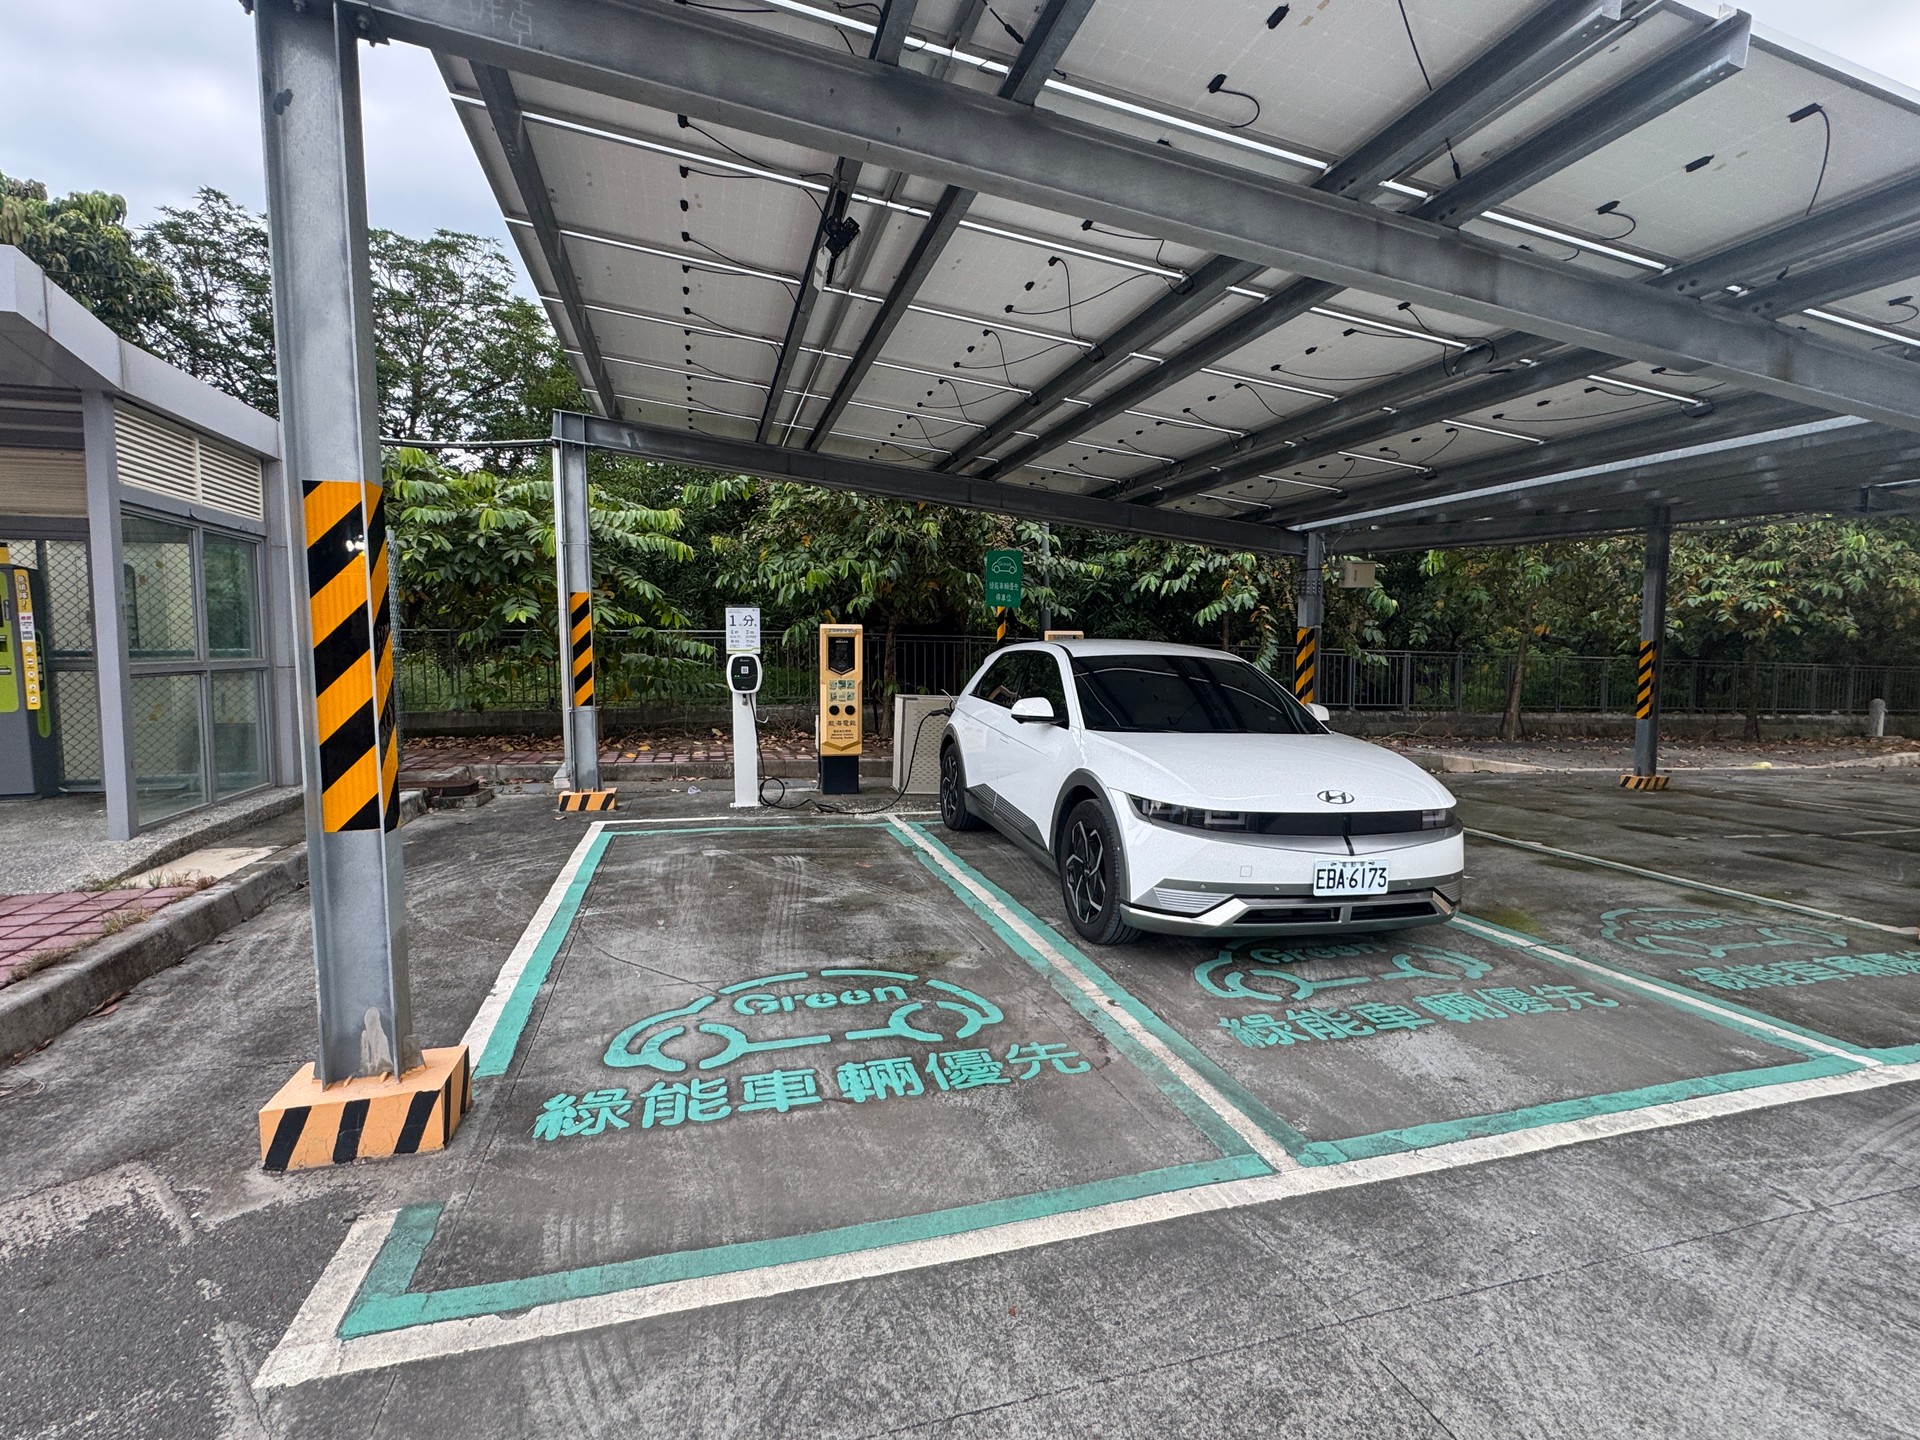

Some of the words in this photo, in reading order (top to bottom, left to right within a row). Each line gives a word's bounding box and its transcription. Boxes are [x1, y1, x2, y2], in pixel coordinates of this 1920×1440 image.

[1250, 942, 1388, 964] Green
[732, 985, 909, 1016] Green
[1217, 984, 1620, 1049] 綠能車輛優先
[531, 1041, 1092, 1141] 綠能車輛優先
